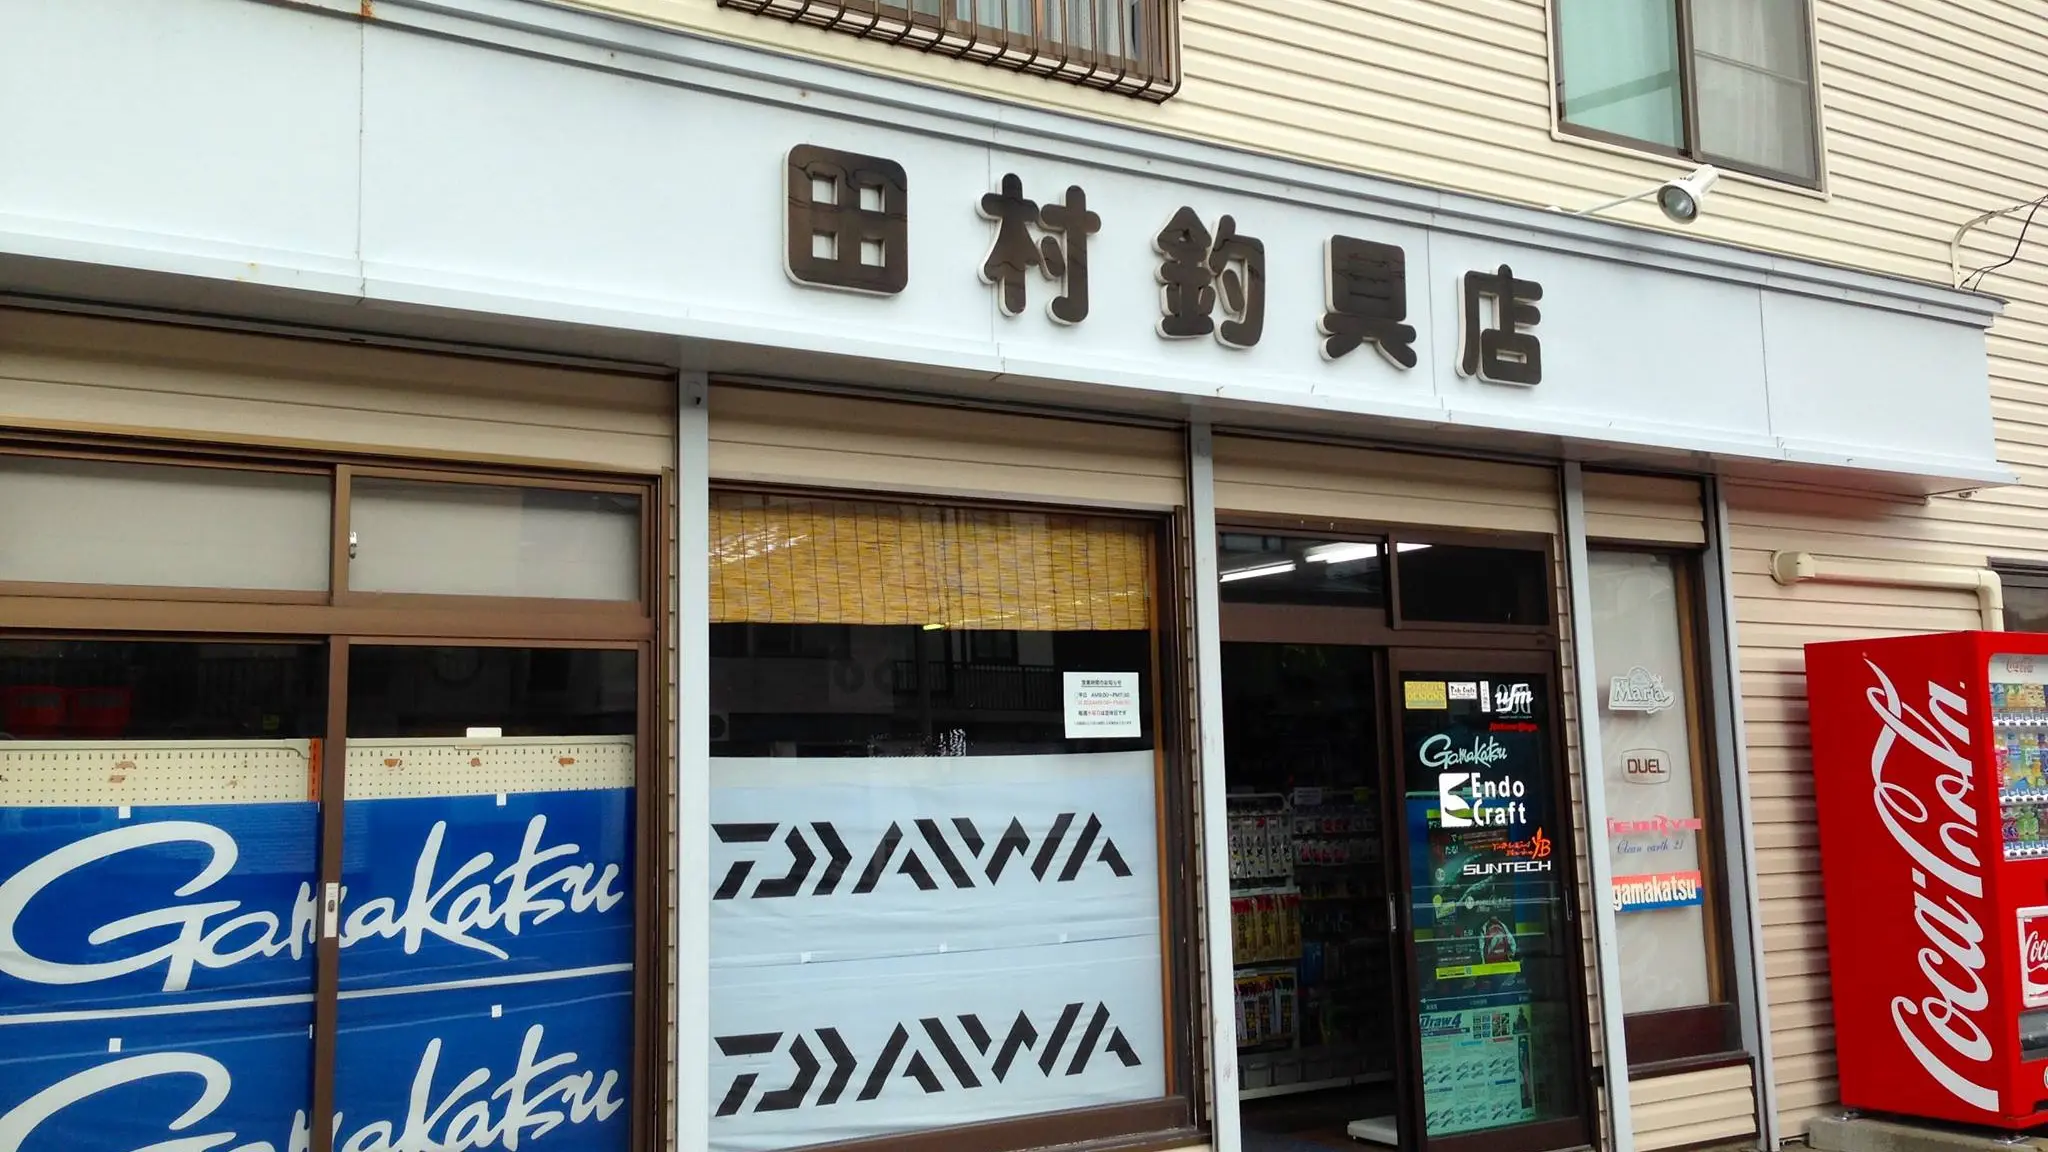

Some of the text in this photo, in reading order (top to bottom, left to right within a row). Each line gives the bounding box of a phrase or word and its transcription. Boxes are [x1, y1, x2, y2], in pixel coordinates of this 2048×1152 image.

[783, 143, 1544, 388] 田村釣具店
[1613, 677, 1670, 703] Maria
[1419, 733, 1508, 769] Gamakatsu
[1627, 758, 1666, 774] DUEL
[1471, 772, 1525, 798] Endo
[1473, 799, 1527, 827] Craft
[1617, 839, 1643, 855] Clean
[1646, 838, 1669, 853] earth
[1463, 860, 1551, 876] SUNTECH
[1612, 875, 1697, 911] gamakatsu
